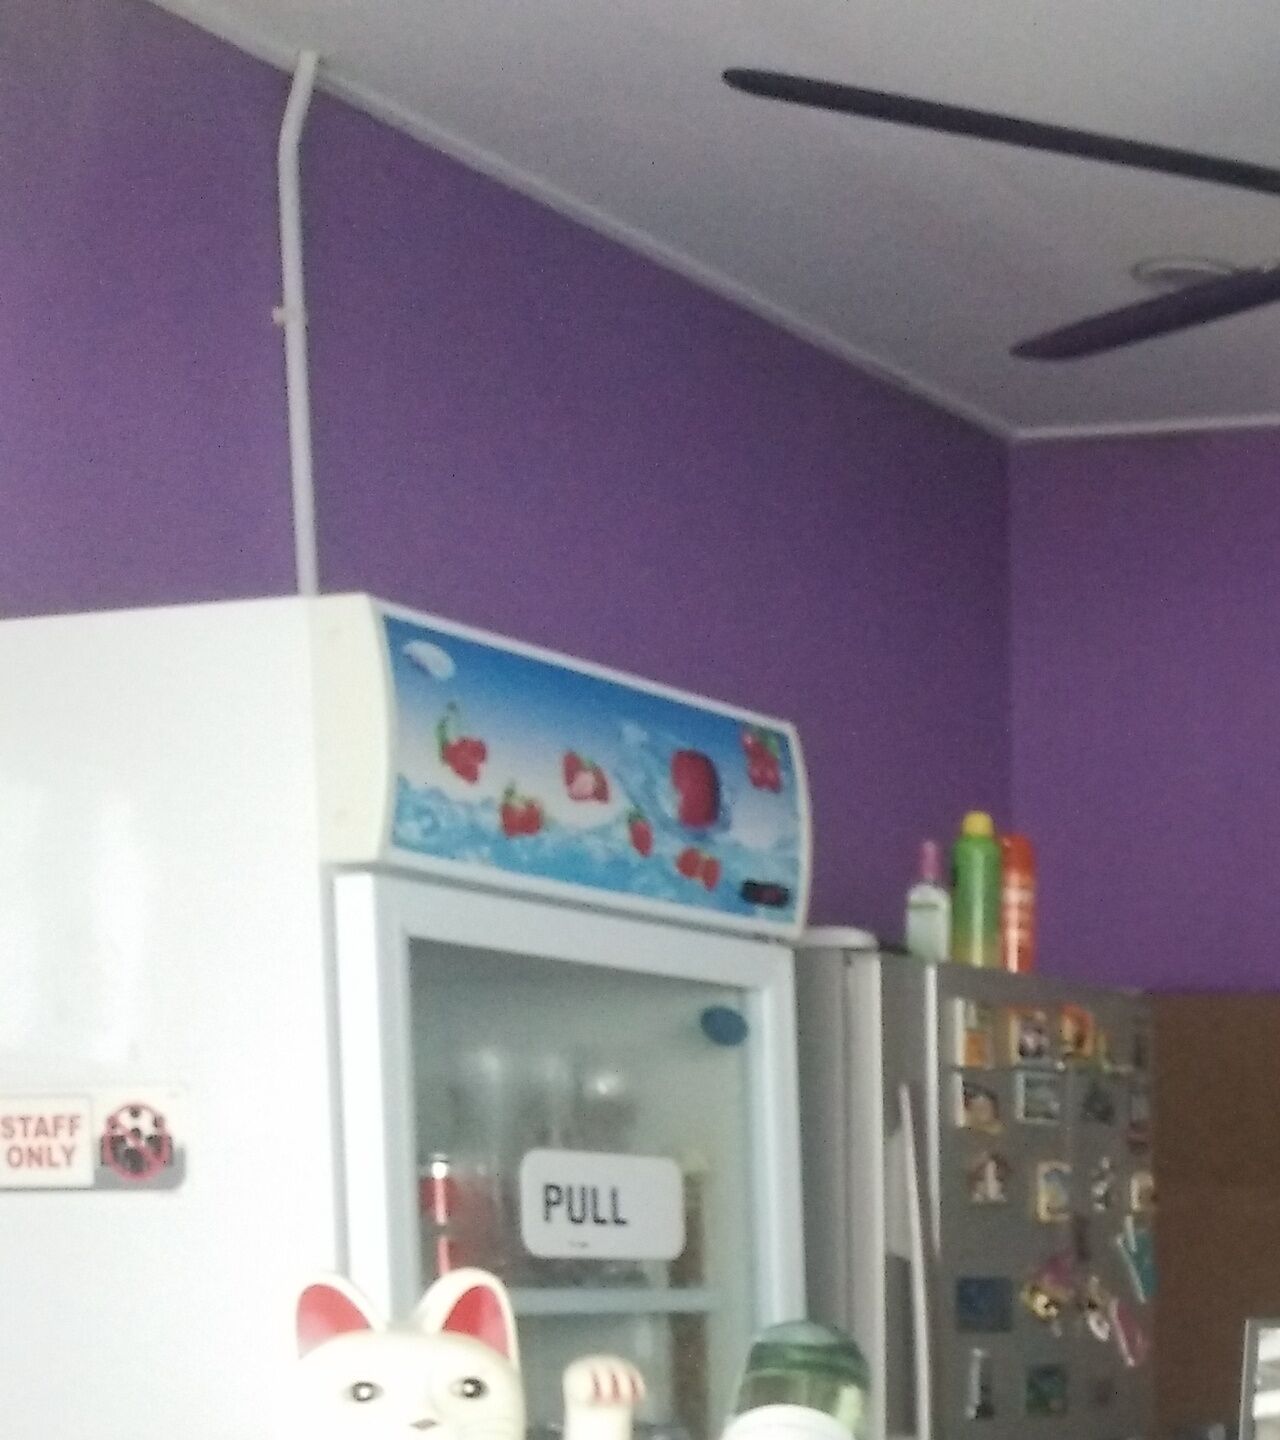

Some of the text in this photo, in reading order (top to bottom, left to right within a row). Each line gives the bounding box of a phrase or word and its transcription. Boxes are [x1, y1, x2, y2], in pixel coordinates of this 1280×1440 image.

[0, 1114, 81, 1140] STAFF
[6, 1145, 76, 1169] ONLY
[542, 1184, 628, 1225] PULL
